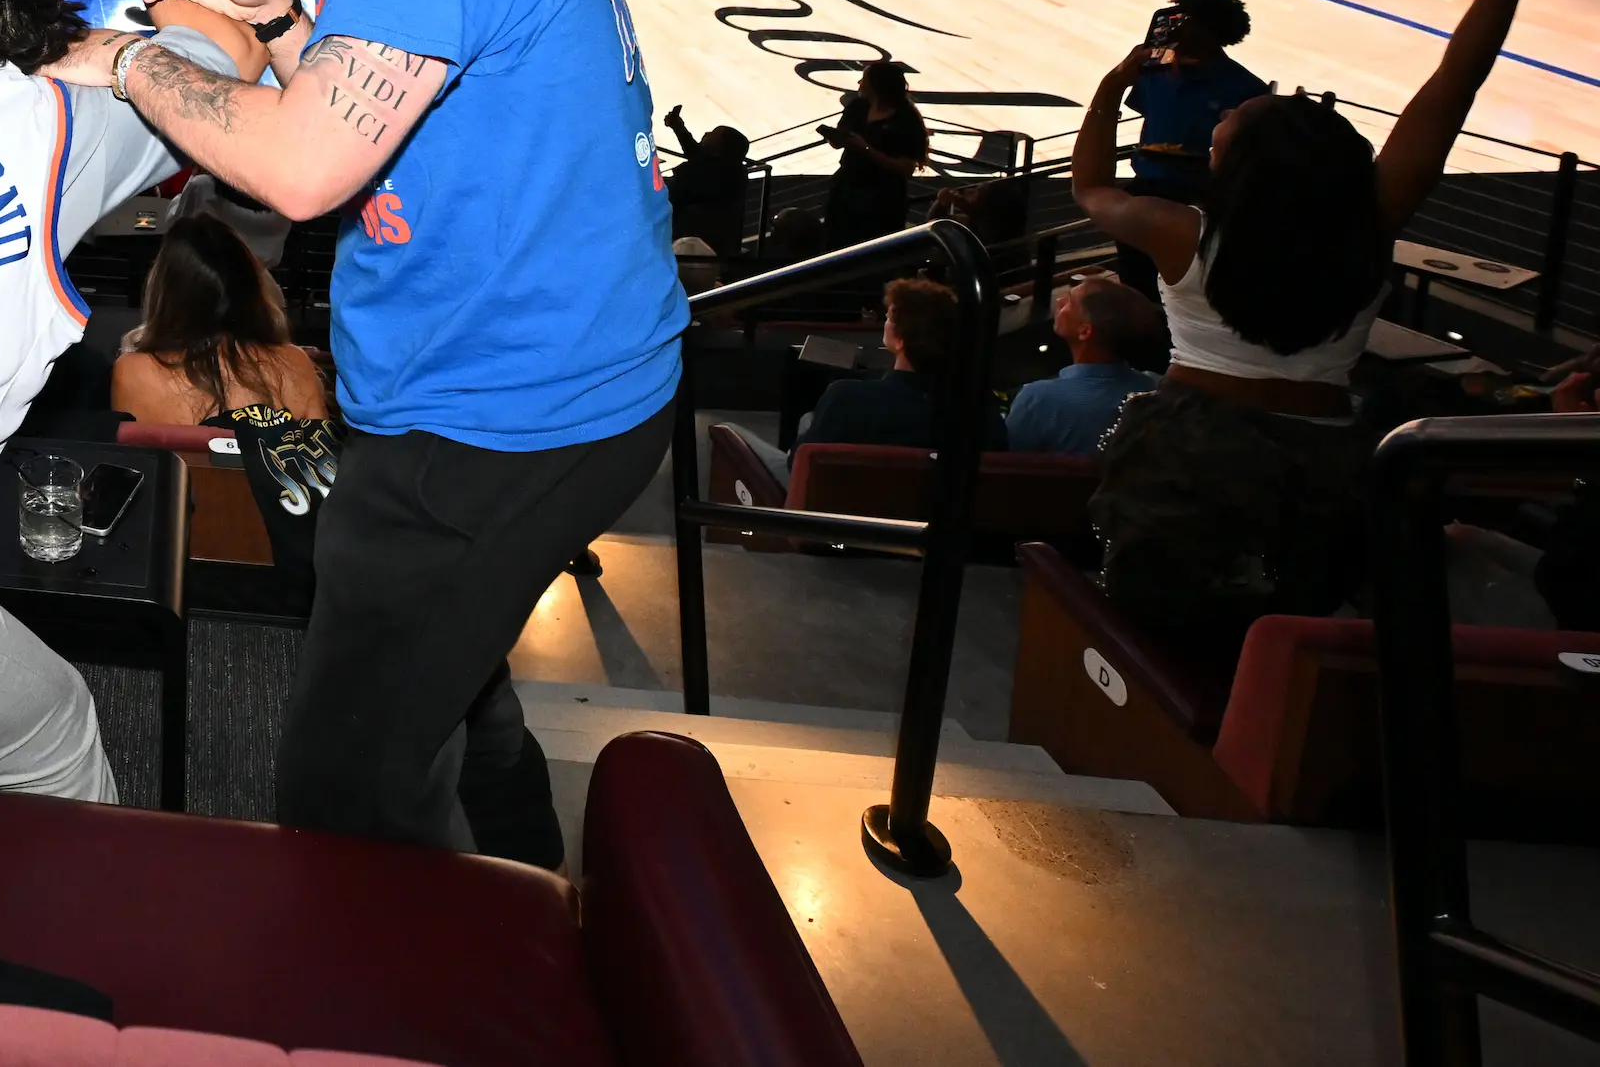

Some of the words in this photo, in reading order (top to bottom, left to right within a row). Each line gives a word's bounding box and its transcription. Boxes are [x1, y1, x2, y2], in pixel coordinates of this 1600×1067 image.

[362, 39, 429, 78] ENI
[345, 56, 408, 111] VIDI
[328, 84, 389, 146] VICI
[1099, 665, 1110, 687] D
